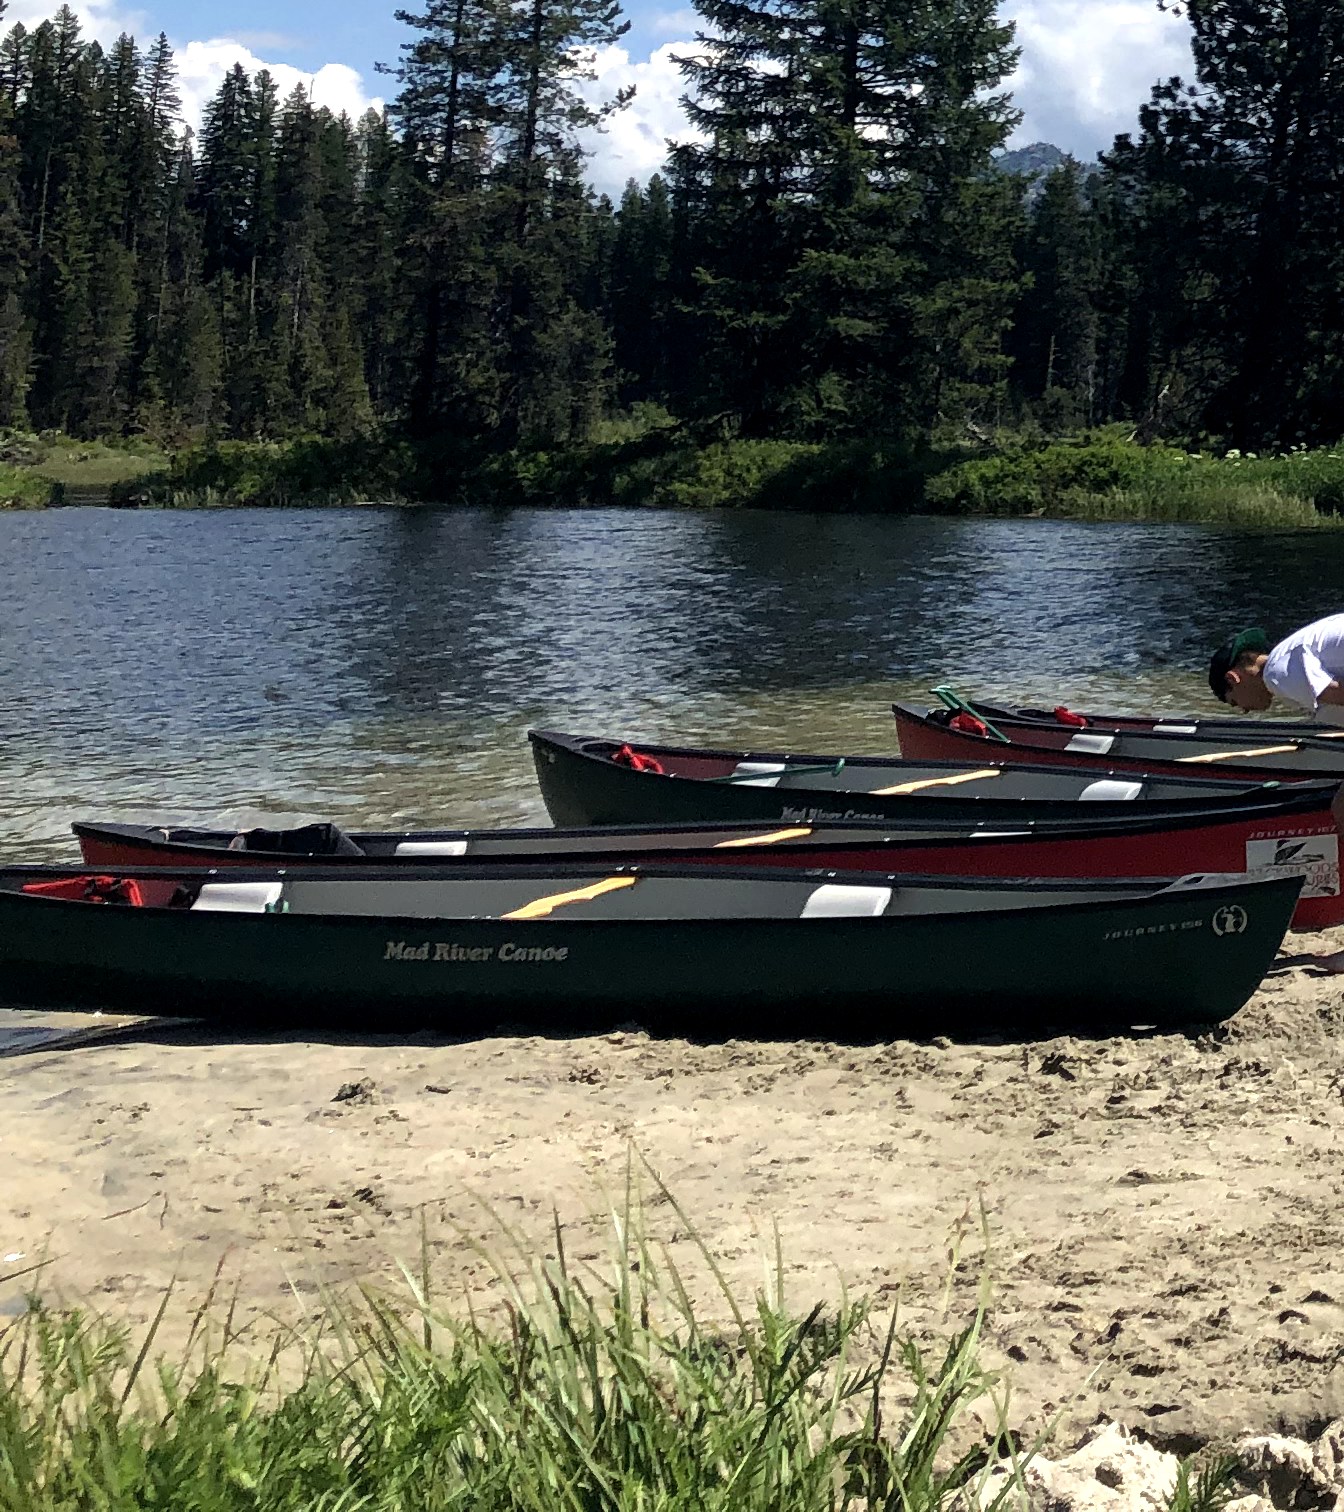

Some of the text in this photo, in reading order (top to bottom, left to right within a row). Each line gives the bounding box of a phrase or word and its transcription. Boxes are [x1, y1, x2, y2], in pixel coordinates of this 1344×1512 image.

[1249, 828, 1315, 840] JOURNEY
[1103, 923, 1178, 940] JOURNEY
[383, 941, 569, 962] Mad River Canoe
